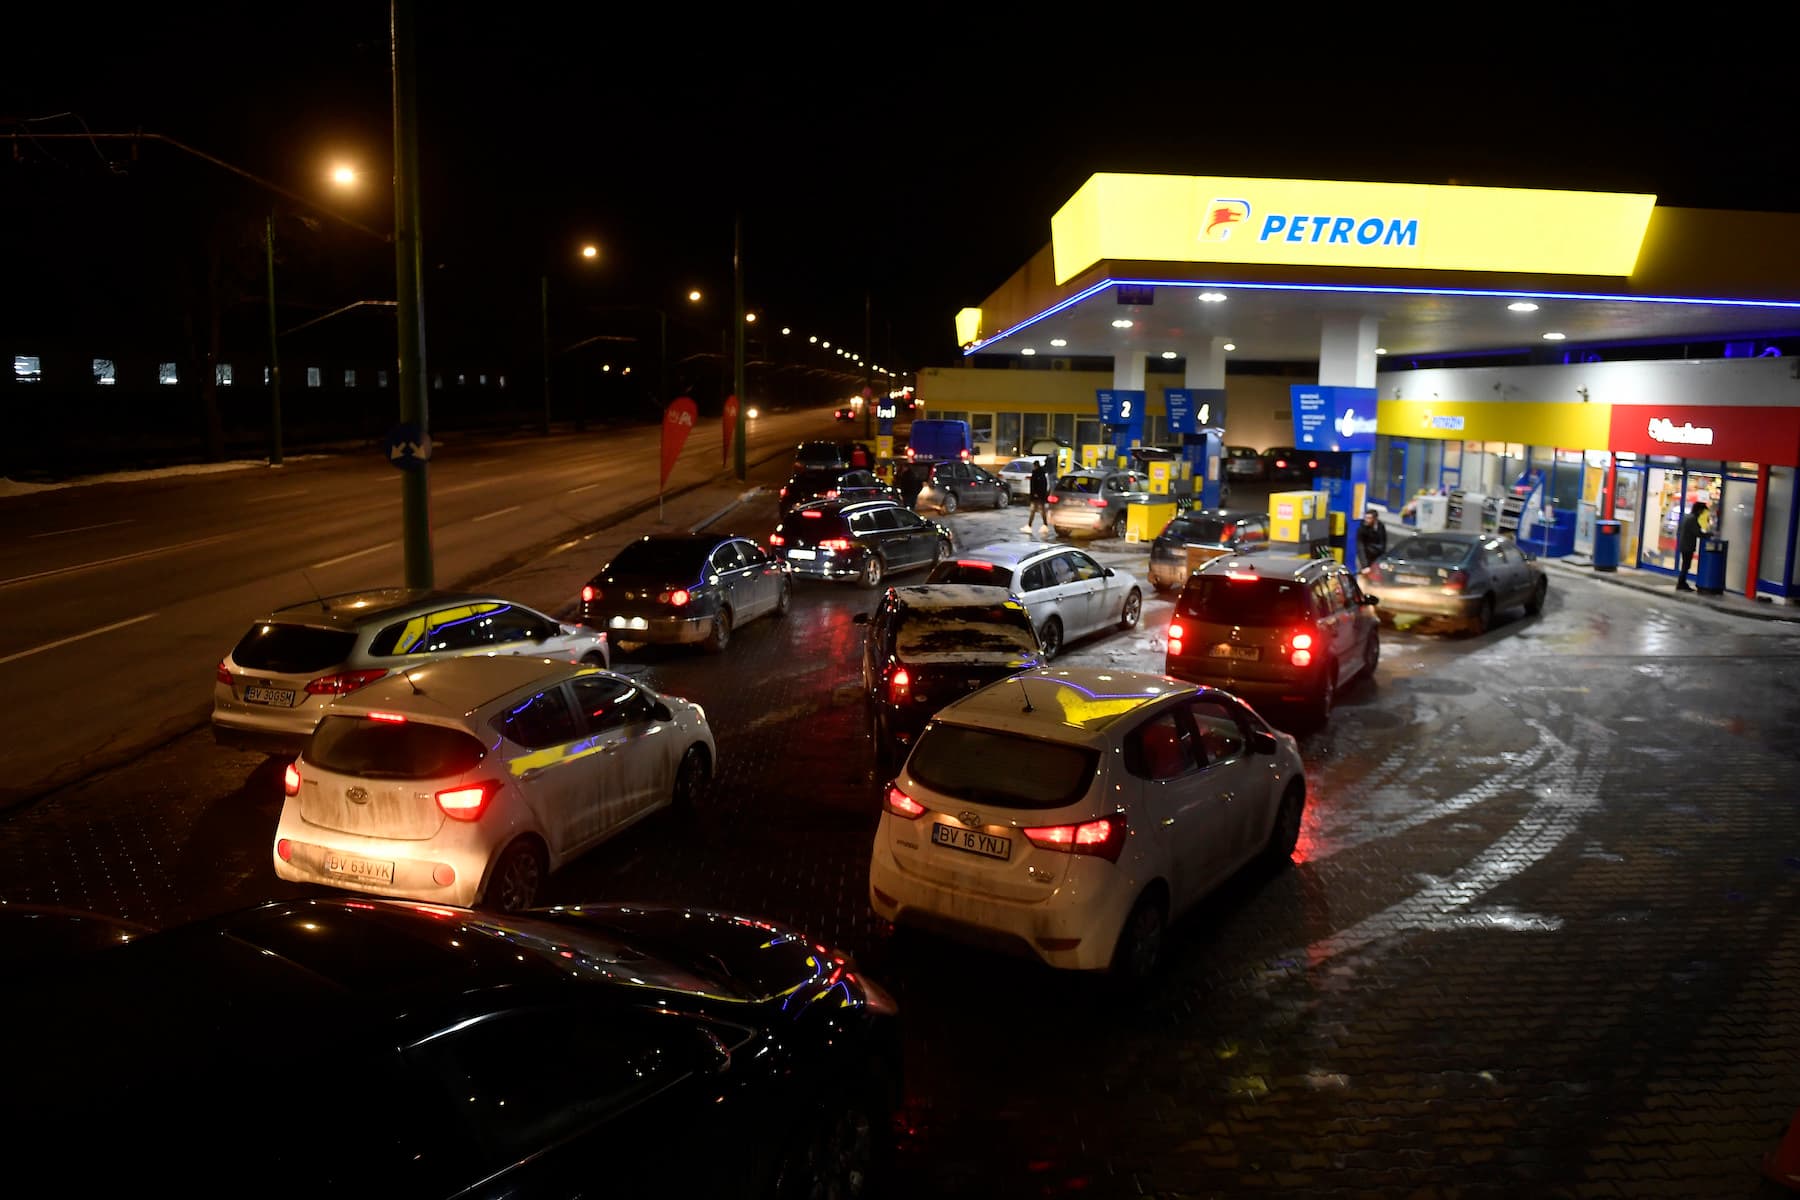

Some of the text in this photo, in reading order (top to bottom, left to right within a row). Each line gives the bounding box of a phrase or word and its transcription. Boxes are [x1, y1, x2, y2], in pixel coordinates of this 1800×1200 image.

[1259, 215, 1418, 246] PETROM
[1120, 401, 1132, 418] 2
[1197, 403, 1210, 425] 4
[940, 827, 1005, 855] BV 16 YNJ
